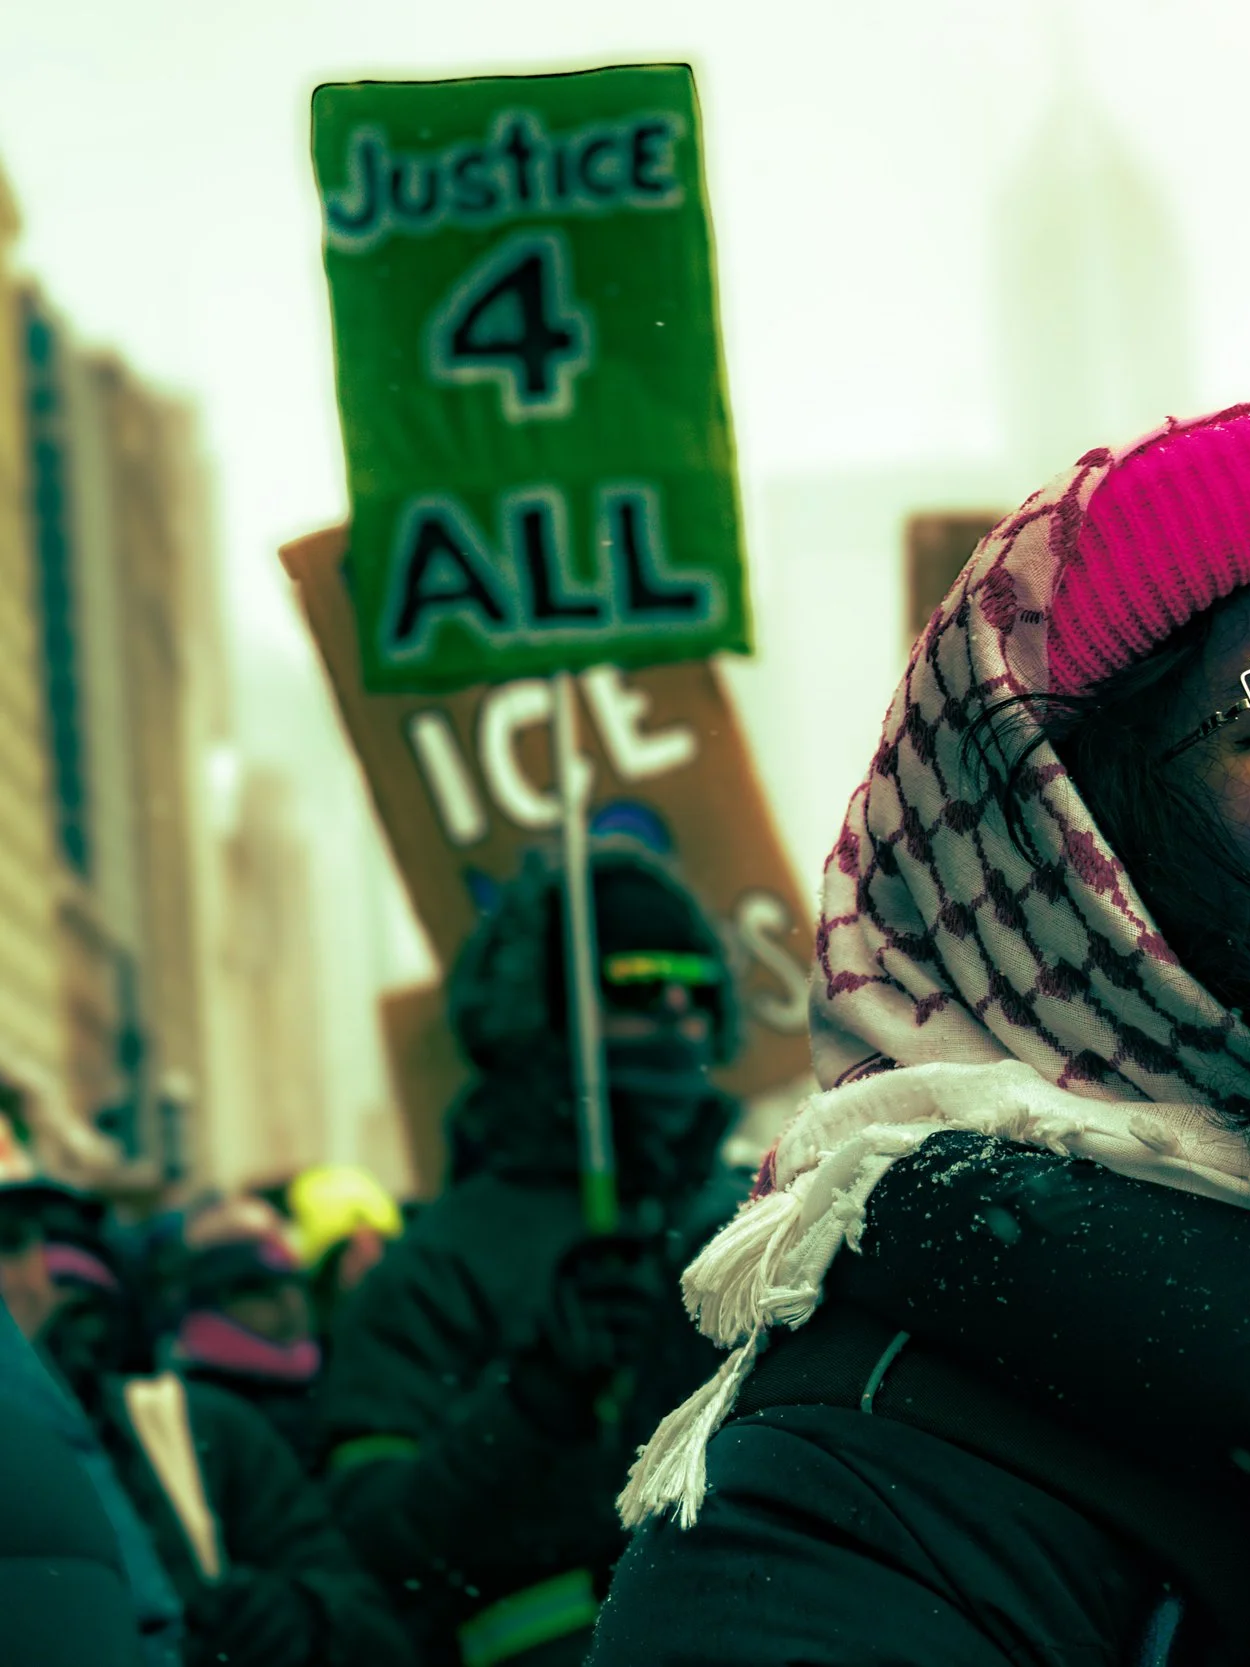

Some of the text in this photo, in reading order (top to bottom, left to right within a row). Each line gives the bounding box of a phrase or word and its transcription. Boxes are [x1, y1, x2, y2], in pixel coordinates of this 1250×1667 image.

[437, 239, 585, 412] 4
[385, 492, 718, 654] ALL
[410, 666, 698, 844] ICE
